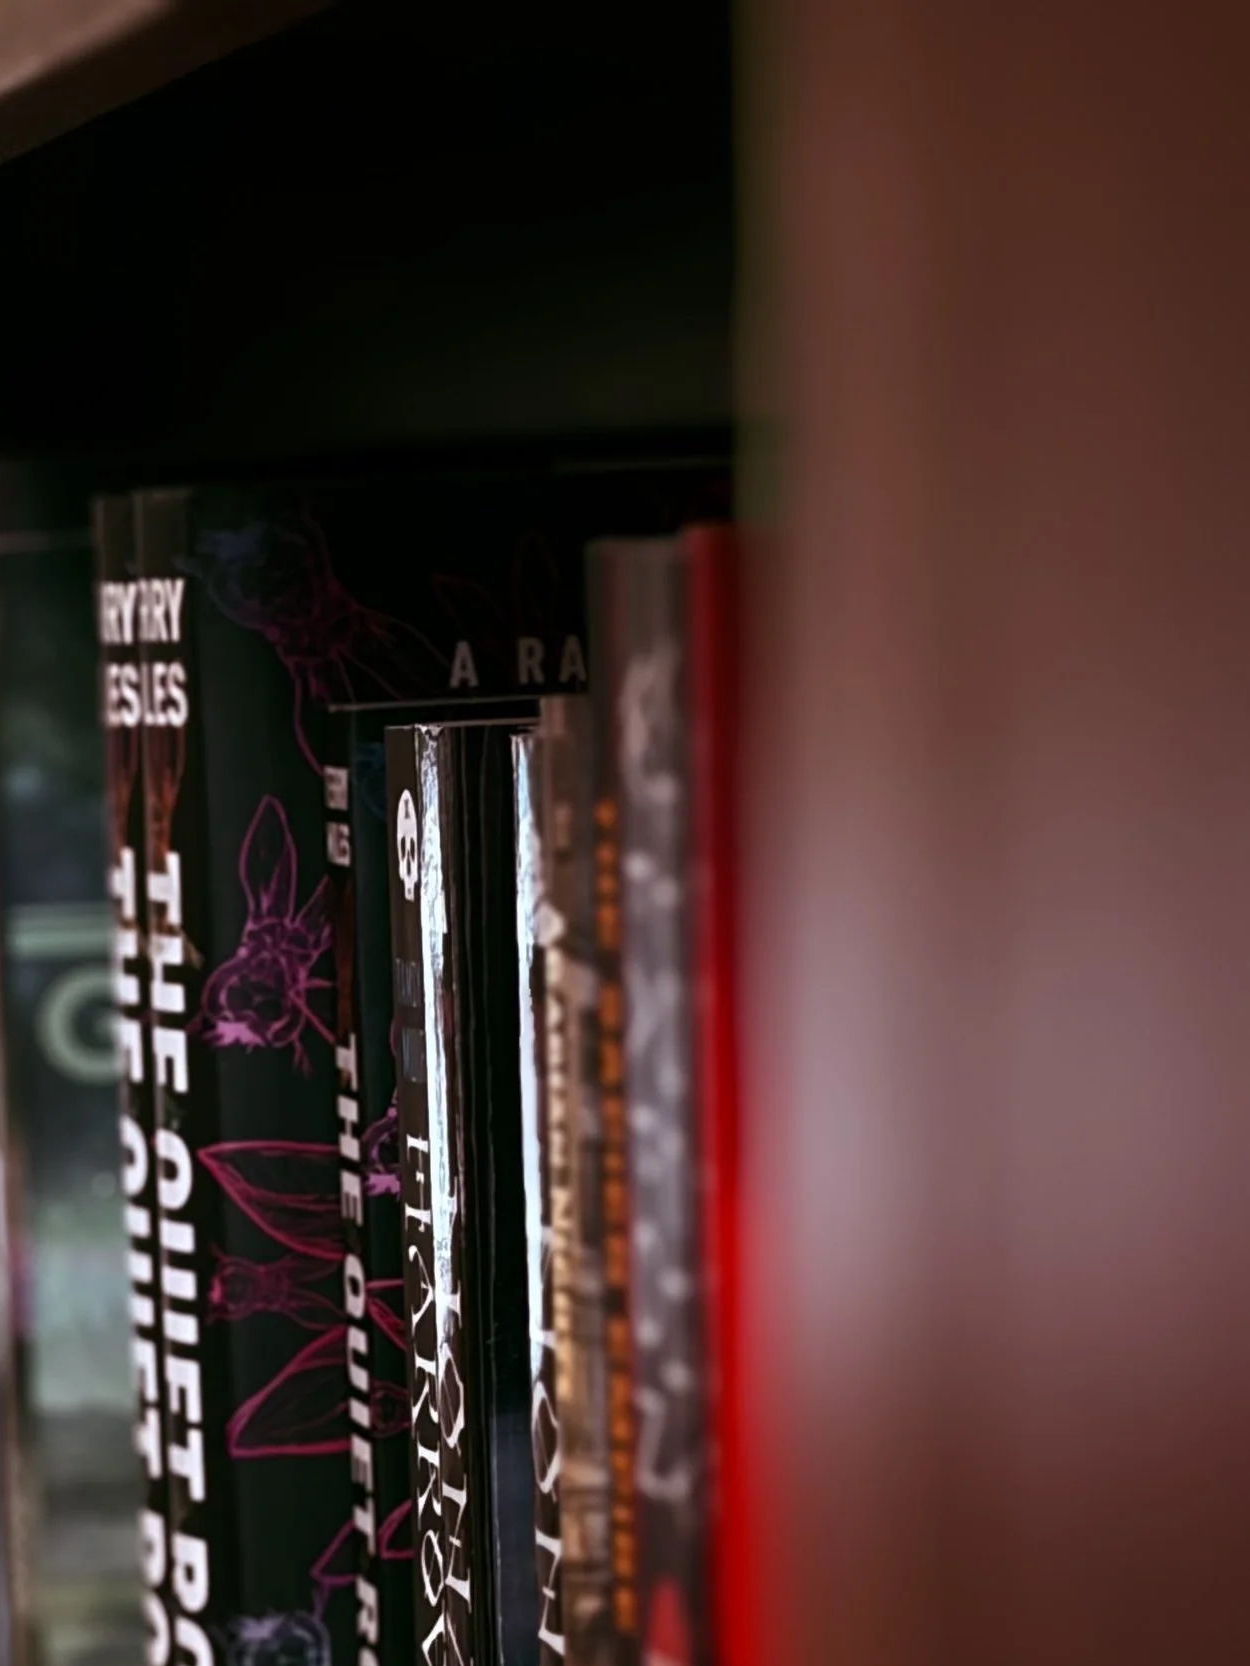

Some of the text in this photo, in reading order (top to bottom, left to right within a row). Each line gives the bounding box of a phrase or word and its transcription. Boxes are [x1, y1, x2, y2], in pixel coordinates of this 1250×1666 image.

[450, 640, 479, 688] A
[335, 1033, 364, 1228] THE
[342, 1252, 376, 1557] QUIET
